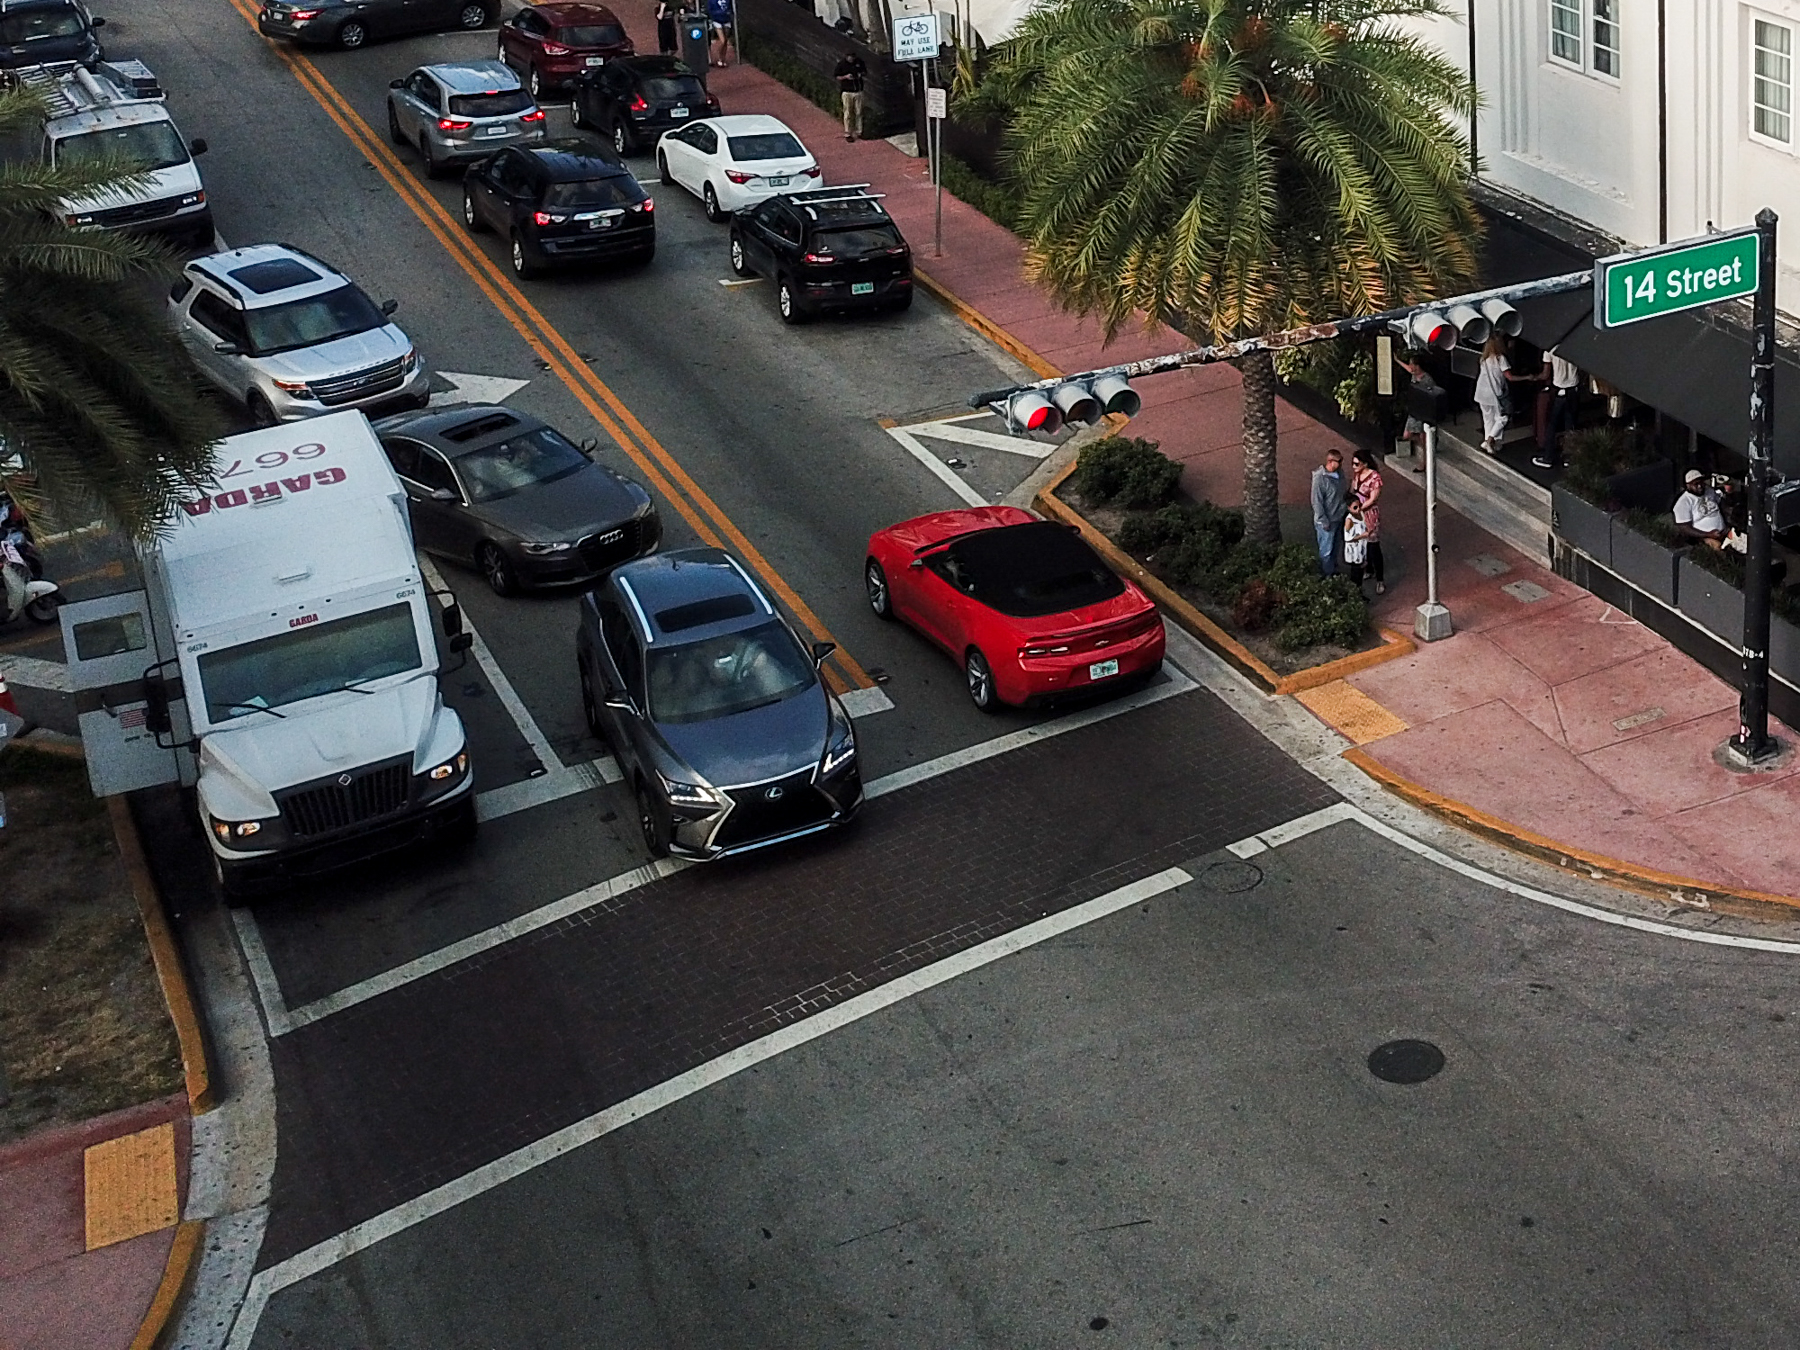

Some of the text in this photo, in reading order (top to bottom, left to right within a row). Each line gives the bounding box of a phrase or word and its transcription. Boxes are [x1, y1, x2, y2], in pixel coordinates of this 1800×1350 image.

[900, 36, 931, 46] MAY USE
[897, 45, 935, 57] FULL LANE
[1624, 255, 1742, 309] 14 Street
[179, 467, 347, 517] GARDA
[289, 613, 319, 629] GARDA
